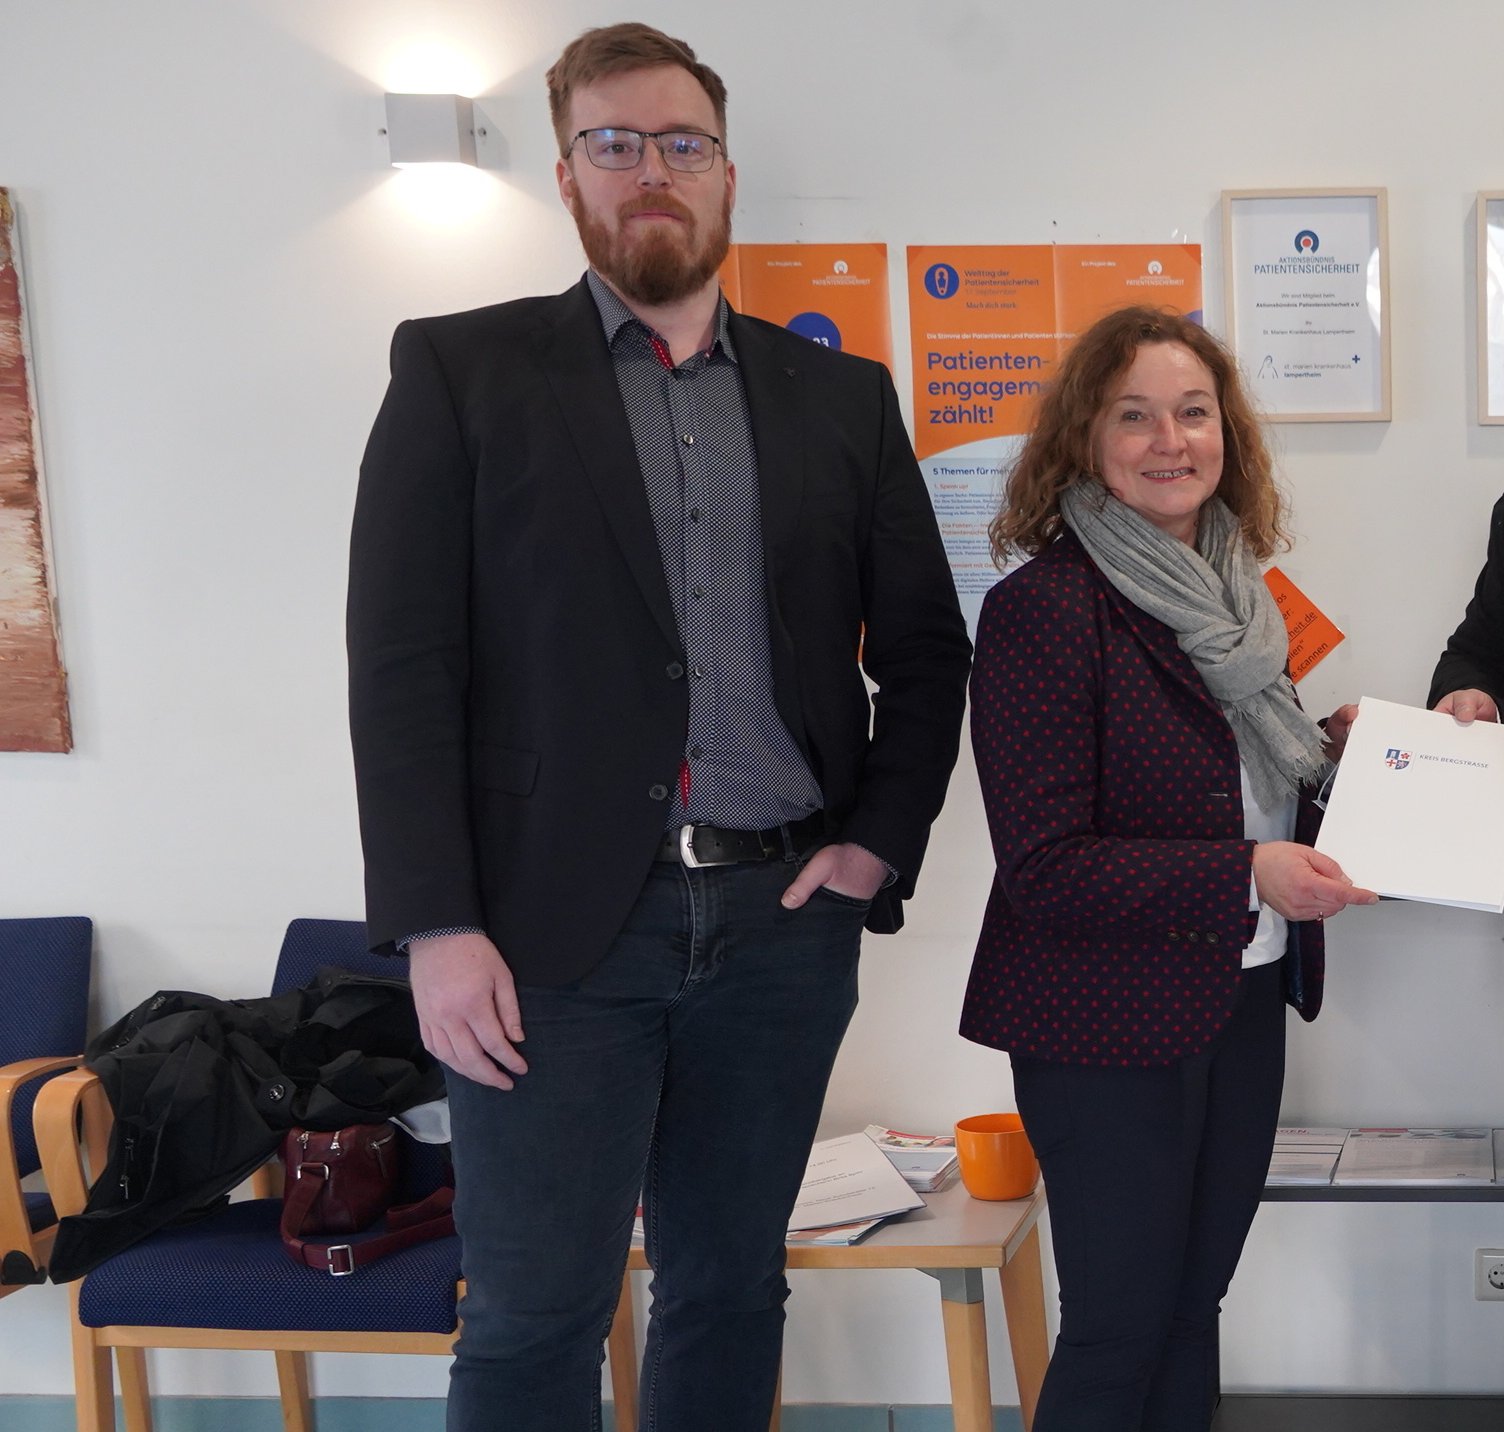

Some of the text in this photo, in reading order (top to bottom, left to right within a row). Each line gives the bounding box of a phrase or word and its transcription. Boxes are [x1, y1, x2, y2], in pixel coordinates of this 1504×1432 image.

[1254, 264, 1360, 275] PATIENTENSICHERHEIT
[927, 351, 1050, 371] Patienten-
[928, 380, 1046, 401] engagem
[929, 404, 994, 424] zählt!
[940, 467, 975, 475] Themen
[976, 467, 989, 475] für
[1297, 642, 1329, 673] scannen
[1440, 757, 1489, 769] BERGSTRASSE
